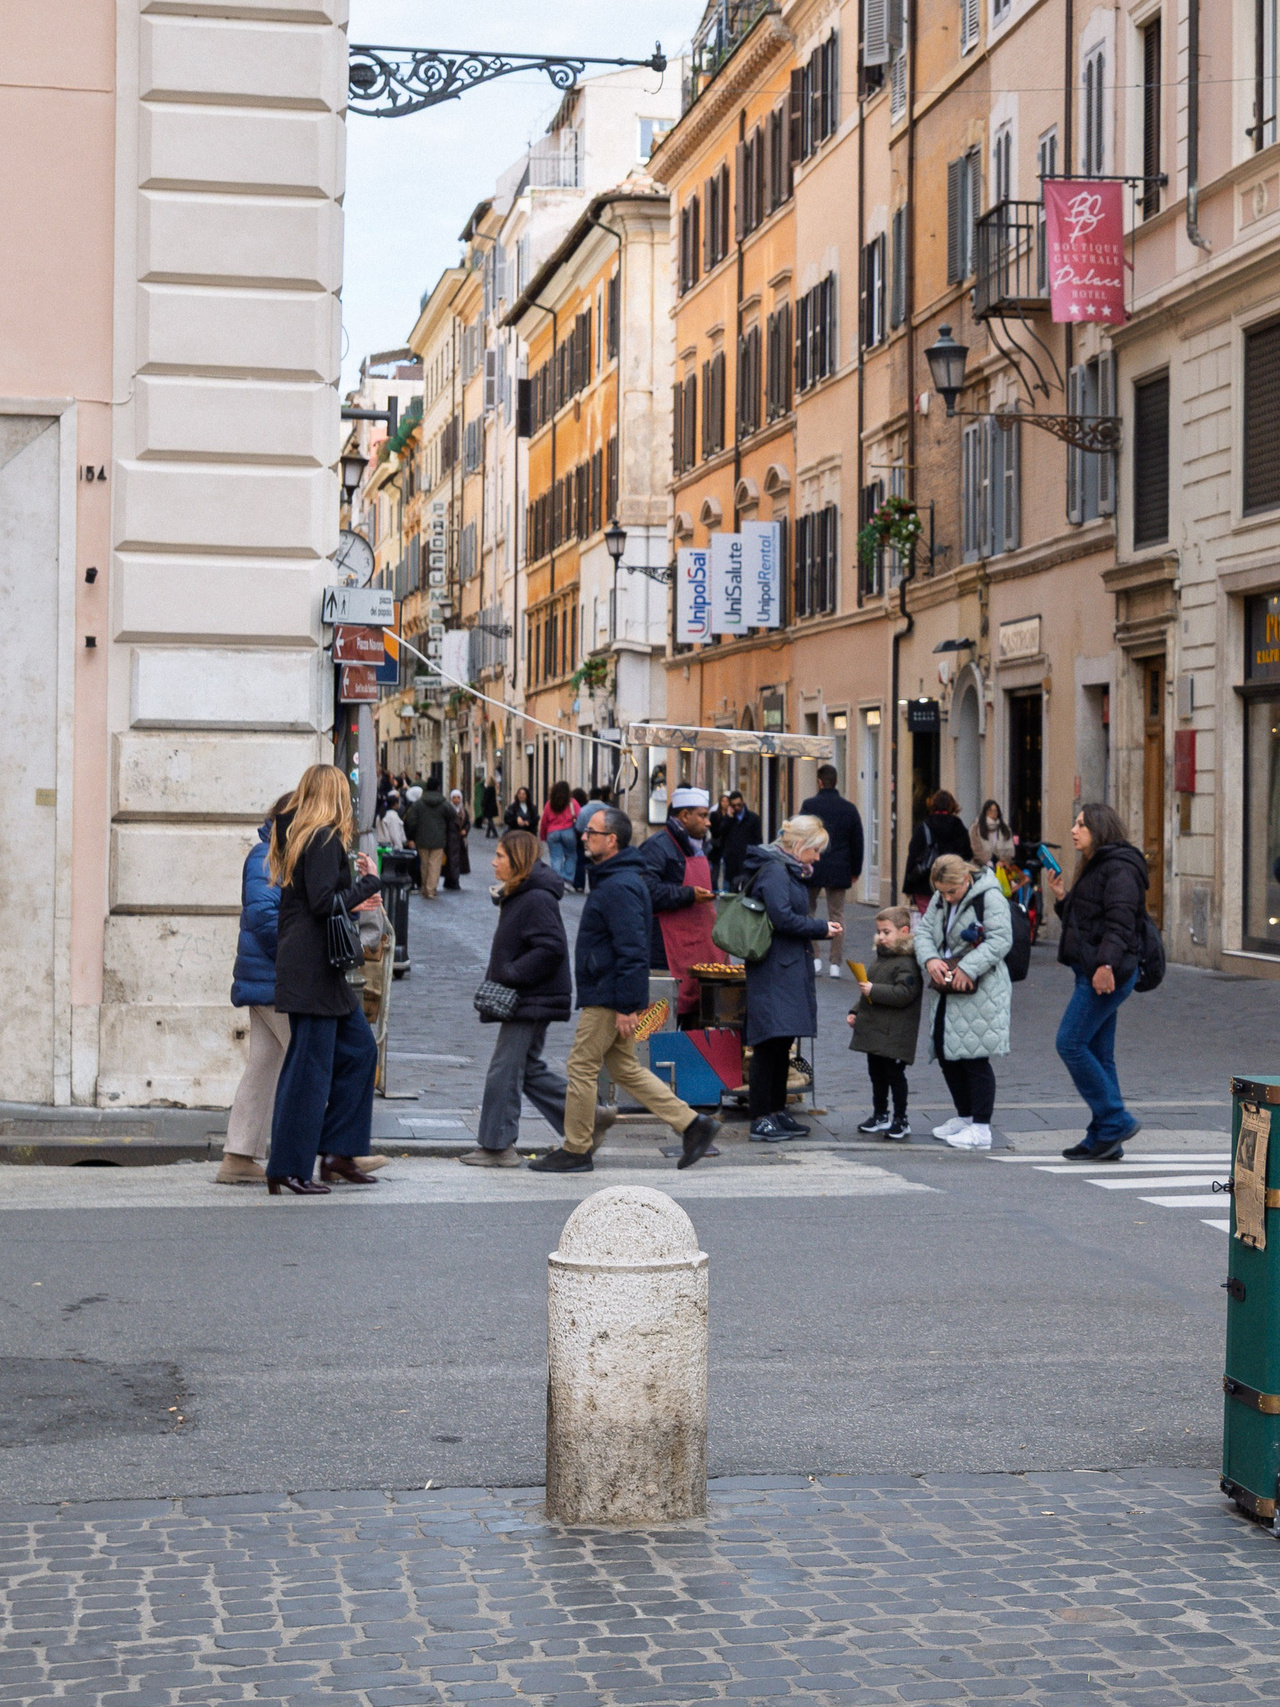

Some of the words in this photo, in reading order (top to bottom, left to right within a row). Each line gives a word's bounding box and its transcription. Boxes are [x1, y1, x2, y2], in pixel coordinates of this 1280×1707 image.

[1053, 242, 1120, 254] BOUTIQUE
[1053, 254, 1120, 266] CENTRALE
[1053, 264, 1122, 290] Palace
[1071, 290, 1108, 300] HOTEL
[79, 465, 107, 483] 154
[725, 541, 743, 625] UniSalute
[757, 534, 777, 623] UnipolRental
[688, 551, 711, 634] UnipolSai
[1257, 648, 1280, 664] RALPH
